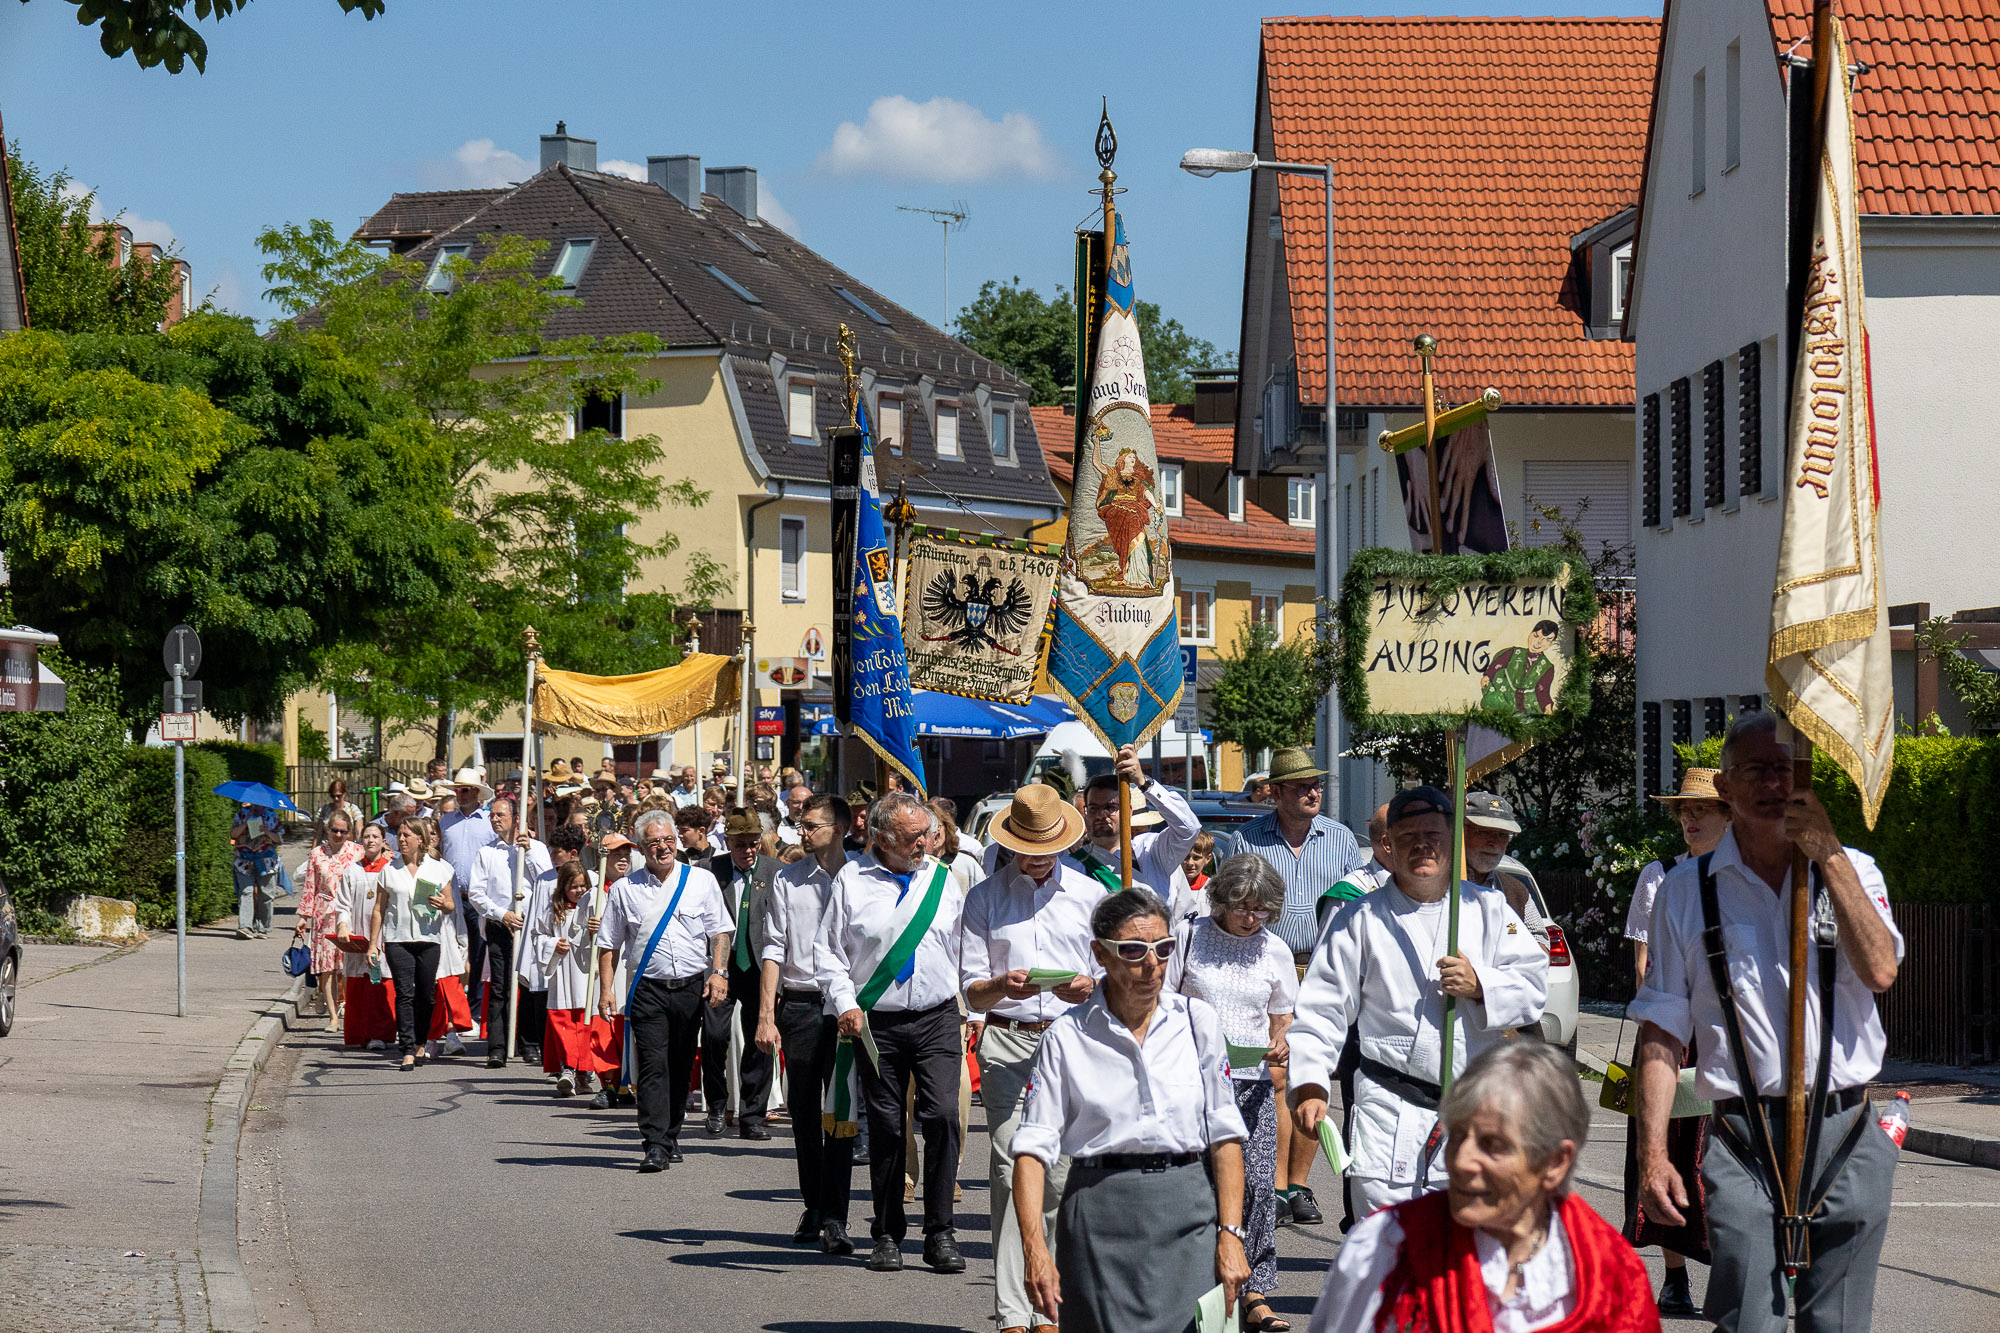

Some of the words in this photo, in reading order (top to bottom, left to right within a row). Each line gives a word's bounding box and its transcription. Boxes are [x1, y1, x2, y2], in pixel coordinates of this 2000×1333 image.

[914, 543, 970, 566] München
[1021, 556, 1054, 577] 1406
[1367, 639, 1492, 675] AUBING
[5, 658, 33, 685] Mühle
[853, 679, 881, 699] den
[759, 709, 776, 720] sky
[758, 724, 777, 732] sport
